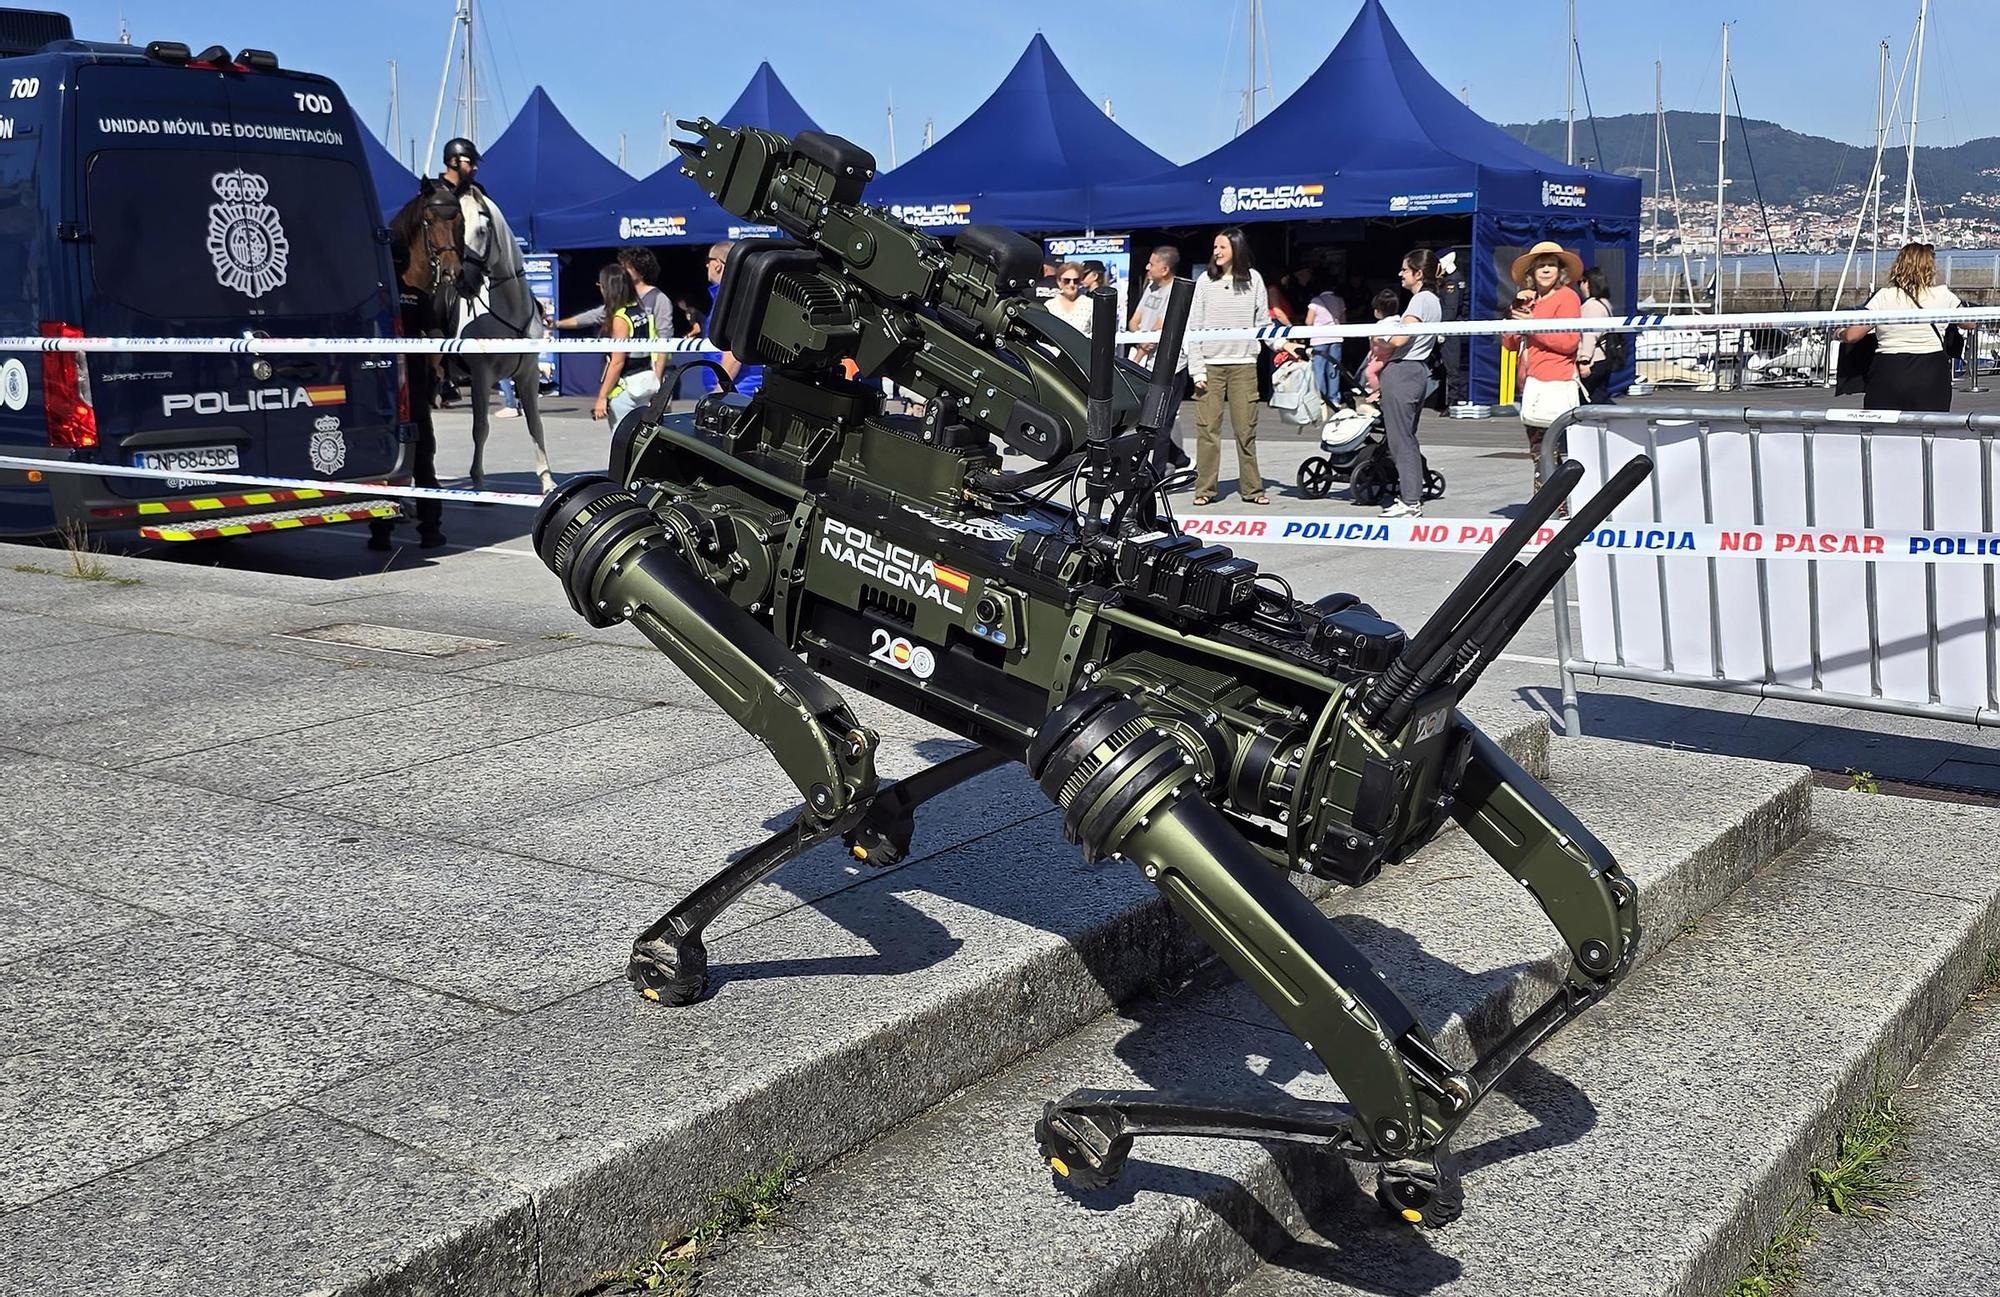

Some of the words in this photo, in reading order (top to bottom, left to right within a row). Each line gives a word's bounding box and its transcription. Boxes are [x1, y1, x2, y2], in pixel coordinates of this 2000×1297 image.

[99, 118, 160, 134] UNIDAD
[163, 117, 210, 136] MÓVIL
[211, 122, 232, 137] DE
[233, 123, 343, 146] DOCUMENTACIÓN
[1237, 185, 1306, 199] POLICIA
[1237, 195, 1324, 211] NACIONAL
[1549, 195, 1586, 207] NACIONAL
[903, 214, 971, 226] NACIONAL
[630, 225, 687, 237] NACIONAL
[1075, 246, 1124, 254] NACIONAL
[146, 449, 237, 471] CNP6845BC
[1182, 519, 1267, 537] PASAR
[1283, 521, 1390, 541] POLICIA
[1409, 525, 1449, 543] NO
[1457, 526, 1555, 546] PAR
[1719, 532, 1763, 552] NO
[1774, 533, 1885, 554] PASAR
[820, 537, 963, 615] NACIONAL
[868, 628, 935, 679] 200
